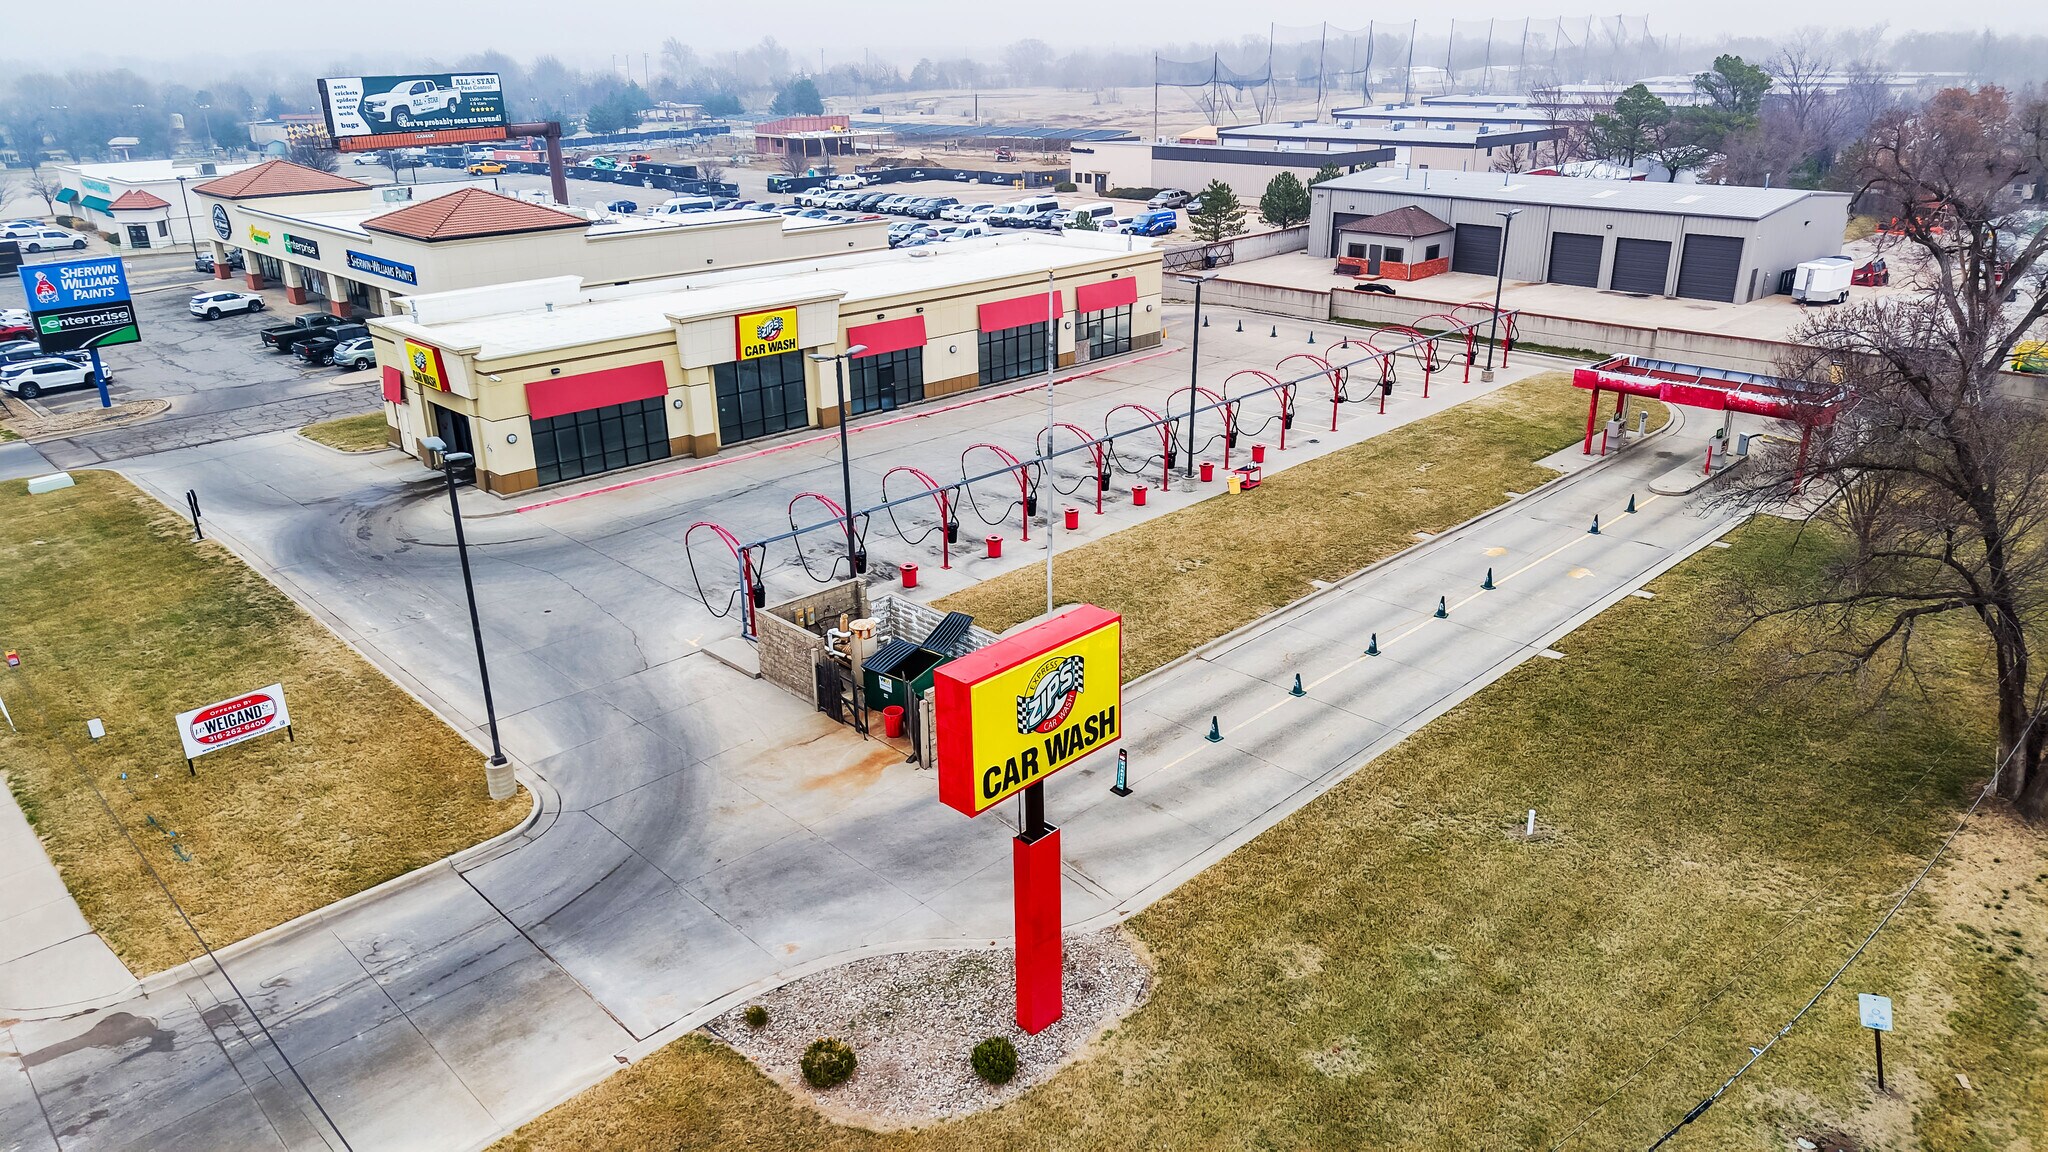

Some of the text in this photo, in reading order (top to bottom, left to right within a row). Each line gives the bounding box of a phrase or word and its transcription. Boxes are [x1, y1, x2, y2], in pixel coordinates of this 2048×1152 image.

[402, 118, 424, 127] You've
[424, 117, 453, 127] probably
[478, 114, 502, 122] around!
[284, 240, 316, 255] enterprise
[60, 264, 116, 279] SHERWIN
[395, 266, 412, 282] PAINTS
[60, 275, 120, 290] WILLIAMS
[73, 287, 114, 301] PAINTS
[46, 310, 128, 328] enterprise
[745, 338, 796, 356] CAR WASH
[1030, 660, 1058, 690] EXPRESS
[1028, 662, 1073, 726] ZIPS
[210, 703, 242, 716] OFFERED
[1044, 694, 1074, 730] CAR WASH
[204, 704, 262, 734] WEIGAND
[208, 719, 266, 742] 316-262-6400
[982, 705, 1116, 799] CAR WASH
